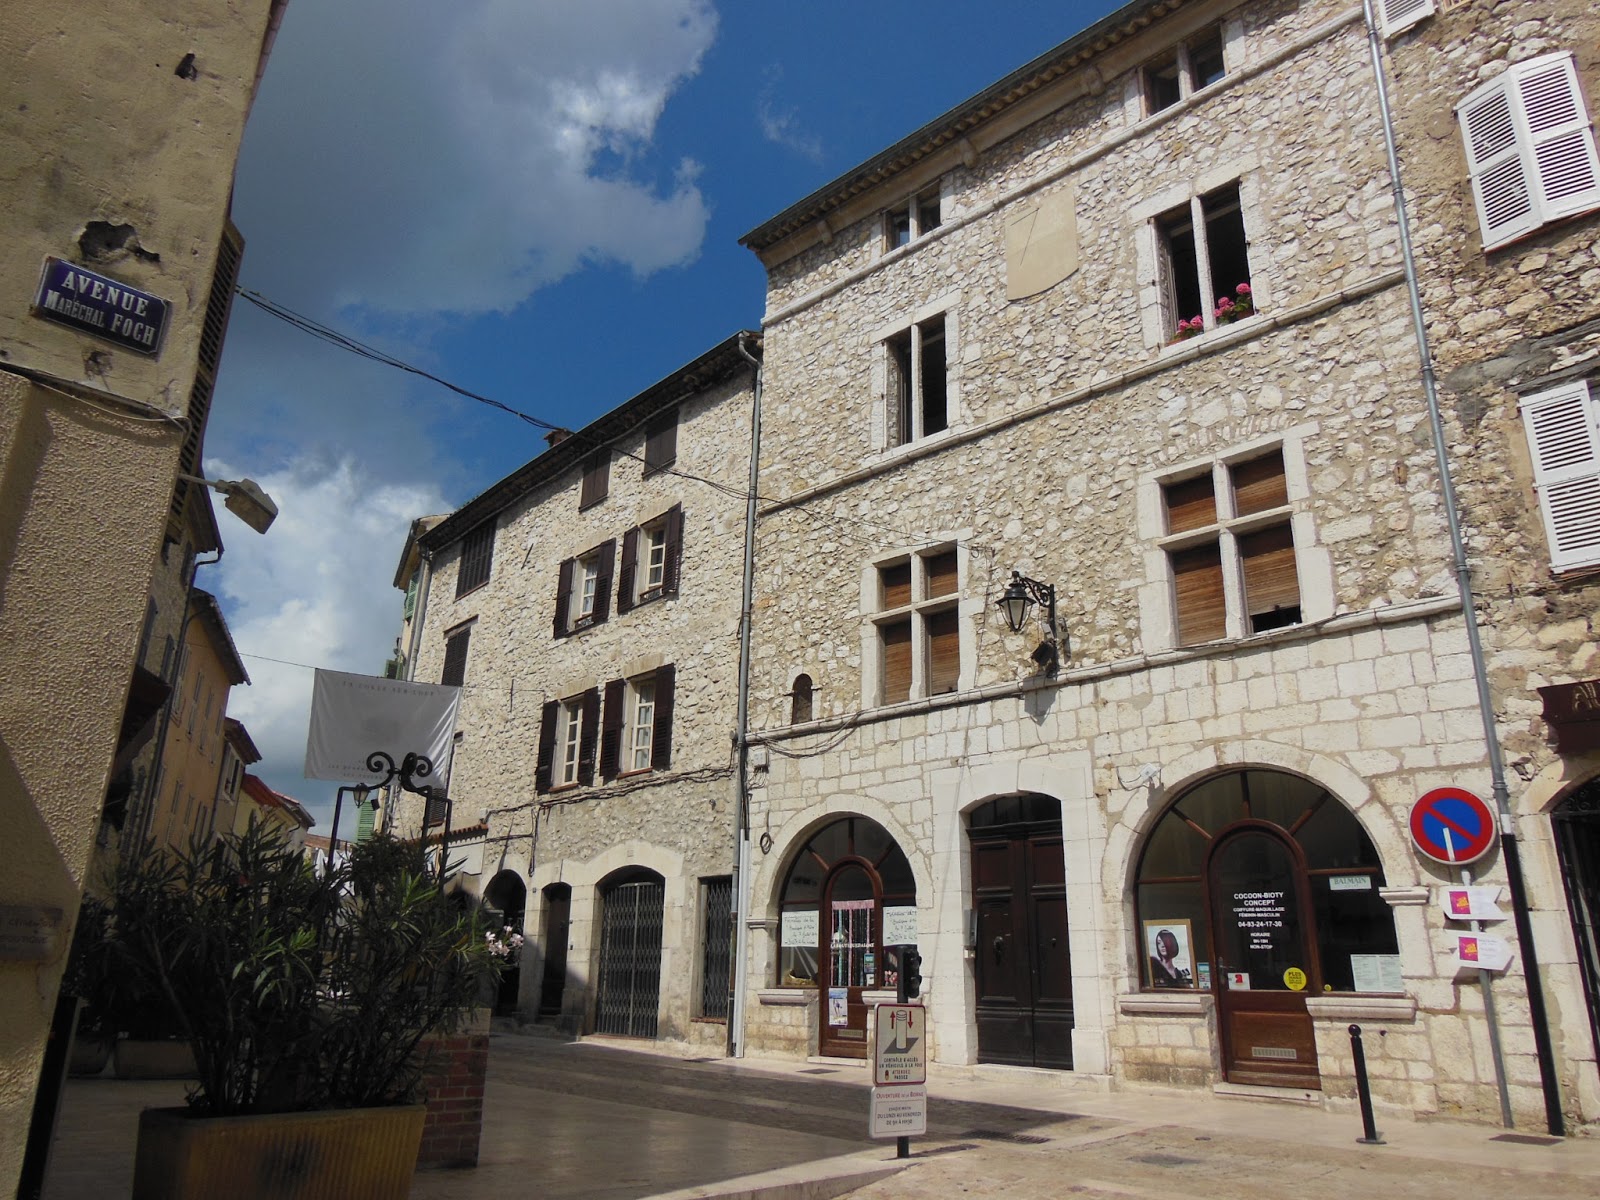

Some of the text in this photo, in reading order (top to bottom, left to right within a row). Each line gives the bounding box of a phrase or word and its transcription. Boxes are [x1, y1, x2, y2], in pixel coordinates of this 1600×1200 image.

[61, 271, 149, 317] AVENUE
[43, 289, 156, 346] MARÉCHAL FOCH
[1334, 877, 1367, 885] BALMAIN
[1233, 892, 1284, 900] COCOON-BIOTY
